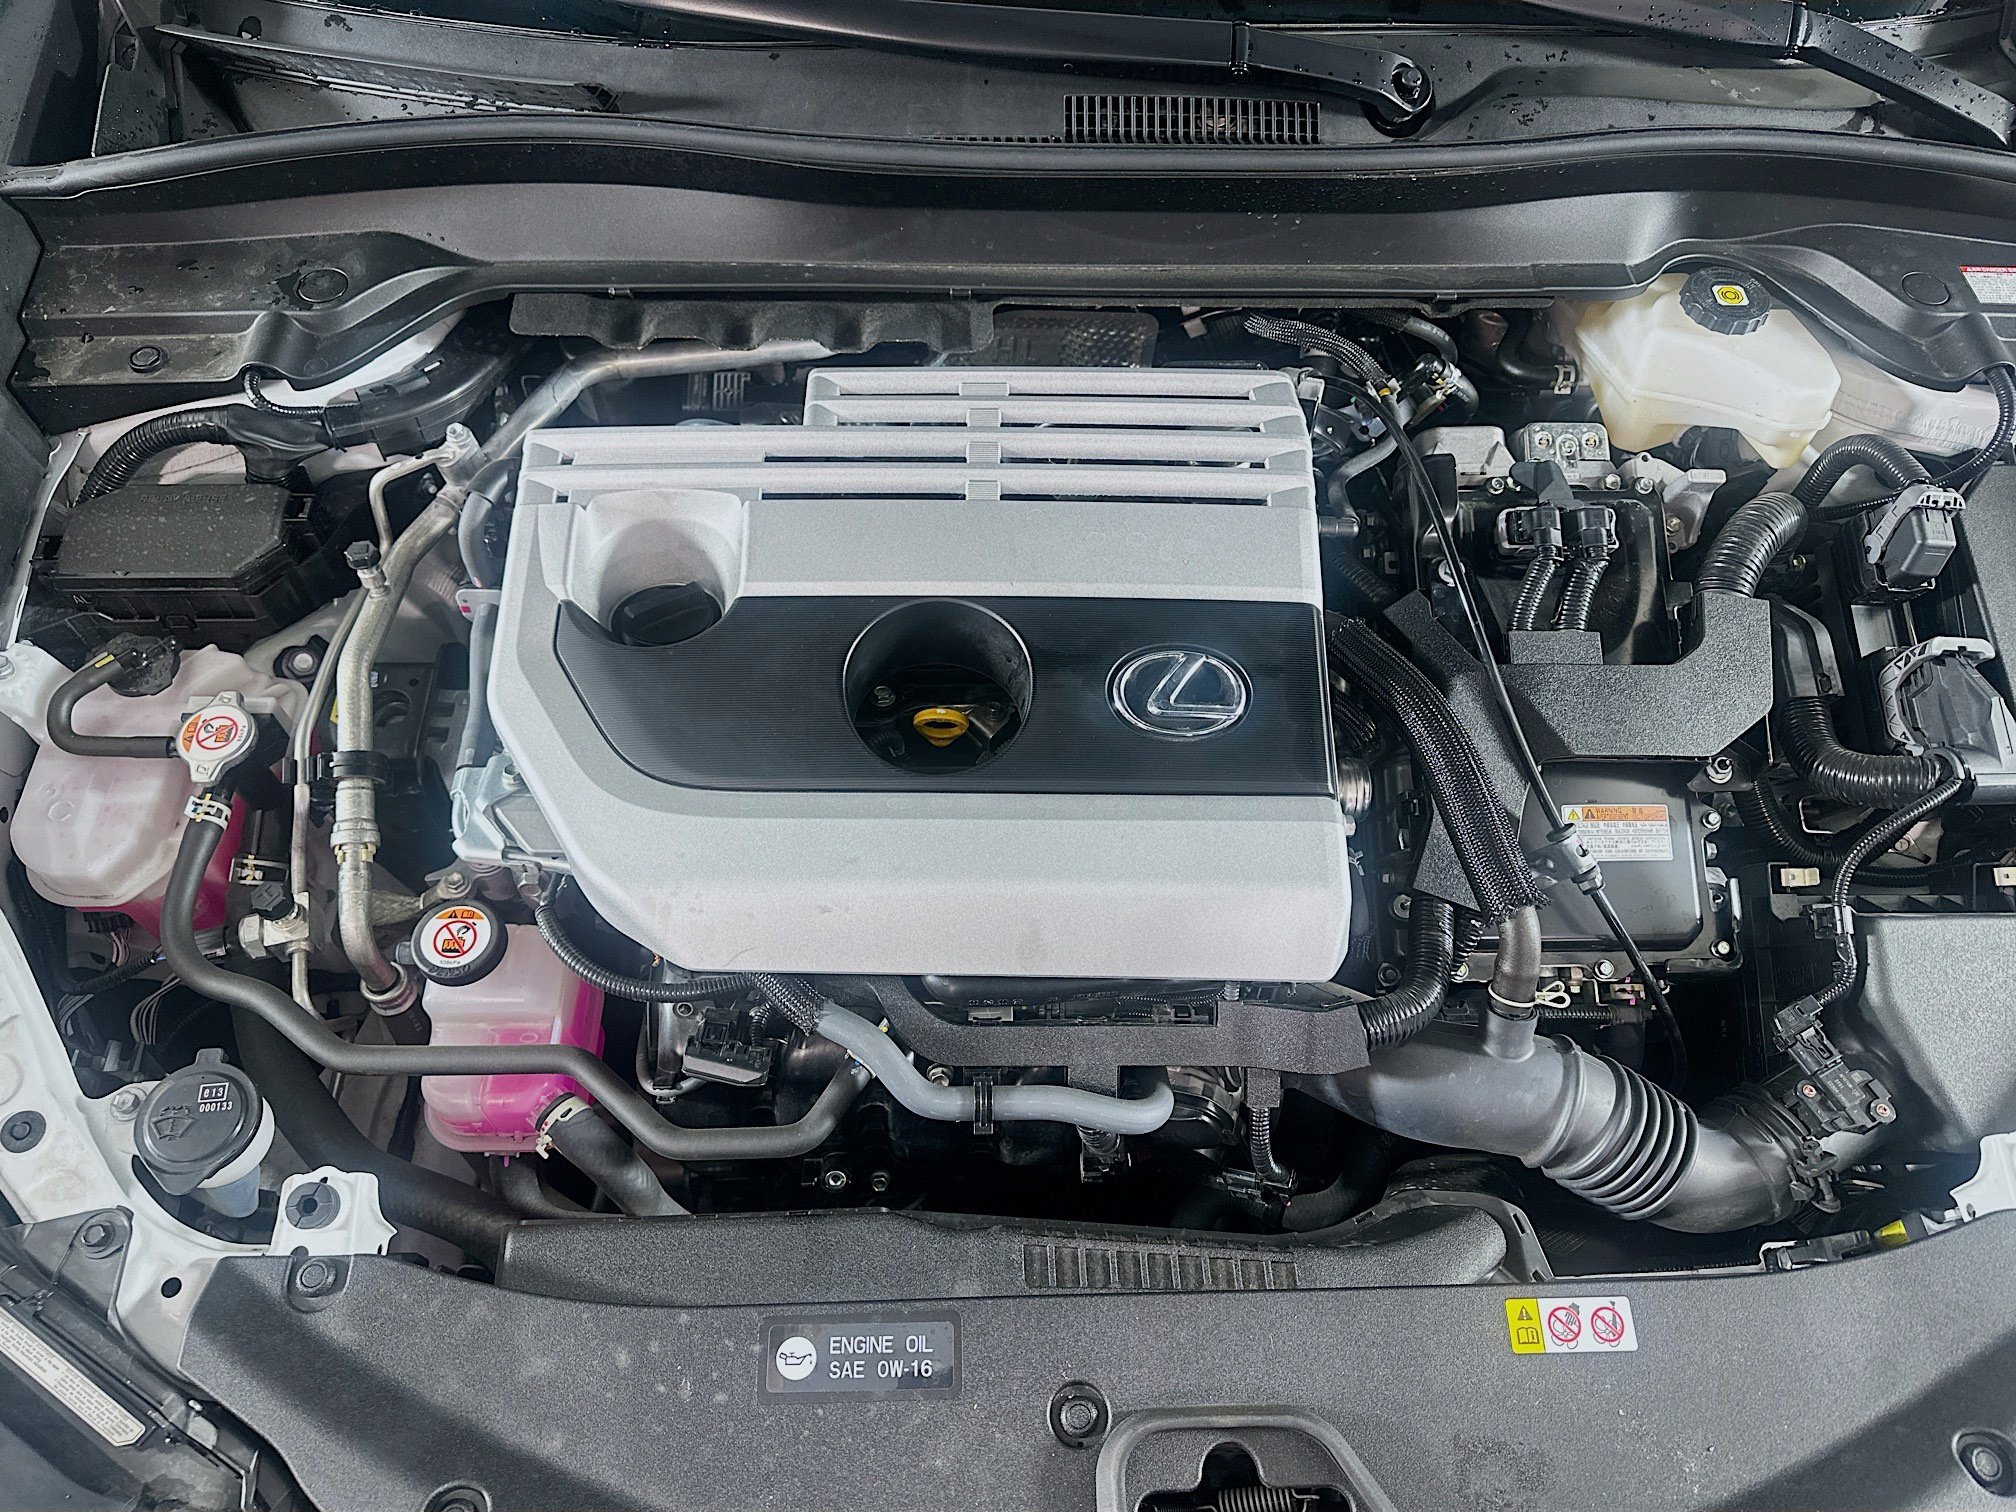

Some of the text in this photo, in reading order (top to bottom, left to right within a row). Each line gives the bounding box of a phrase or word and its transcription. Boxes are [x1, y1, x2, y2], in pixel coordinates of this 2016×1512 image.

[203, 1087, 224, 1098] e13
[199, 1101, 233, 1113] 000133
[829, 1335, 934, 1354] ENGINE OIL
[828, 1359, 933, 1379] SAE 0W-16
